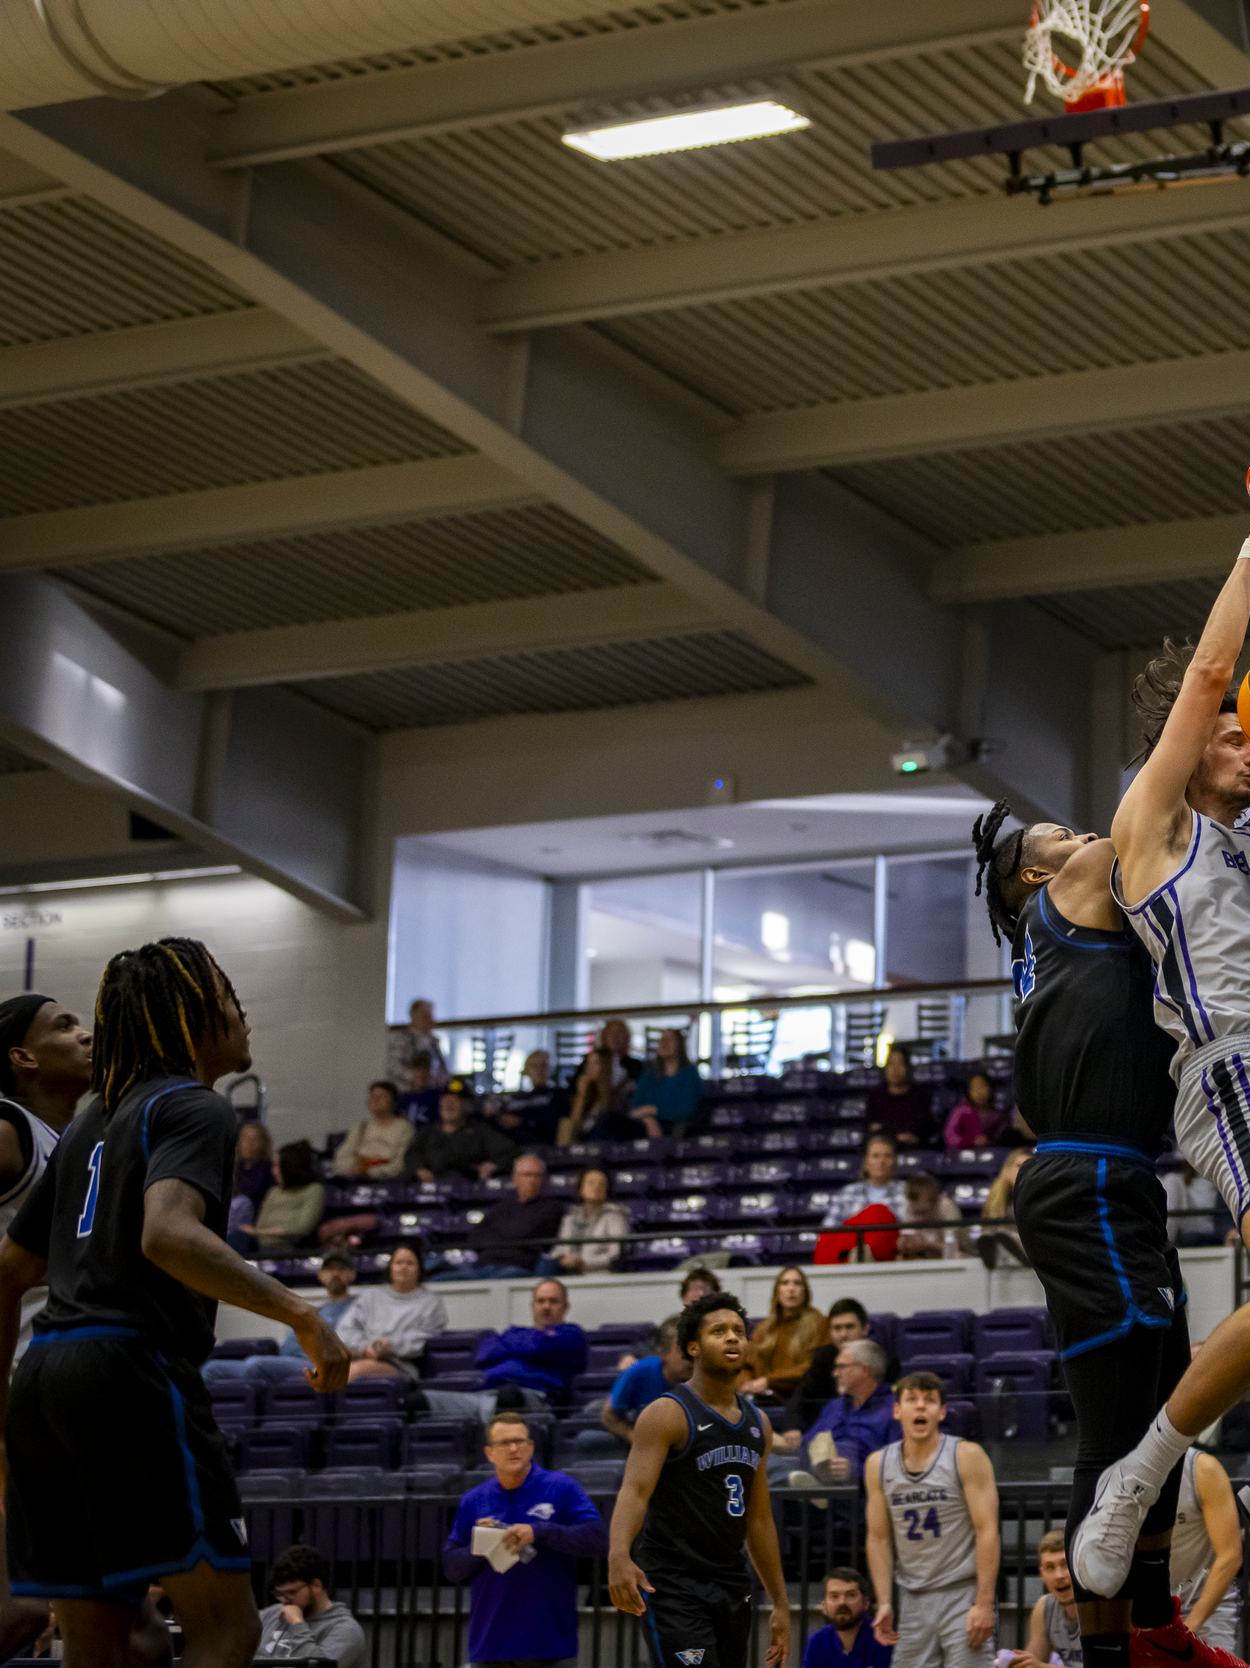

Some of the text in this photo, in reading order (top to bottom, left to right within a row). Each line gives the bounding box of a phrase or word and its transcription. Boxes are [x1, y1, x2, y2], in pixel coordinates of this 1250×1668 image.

[77, 1141, 105, 1239] 1
[696, 1445, 761, 1471] WILLIAM
[724, 1474, 746, 1517] 3
[904, 1507, 941, 1541] 24
